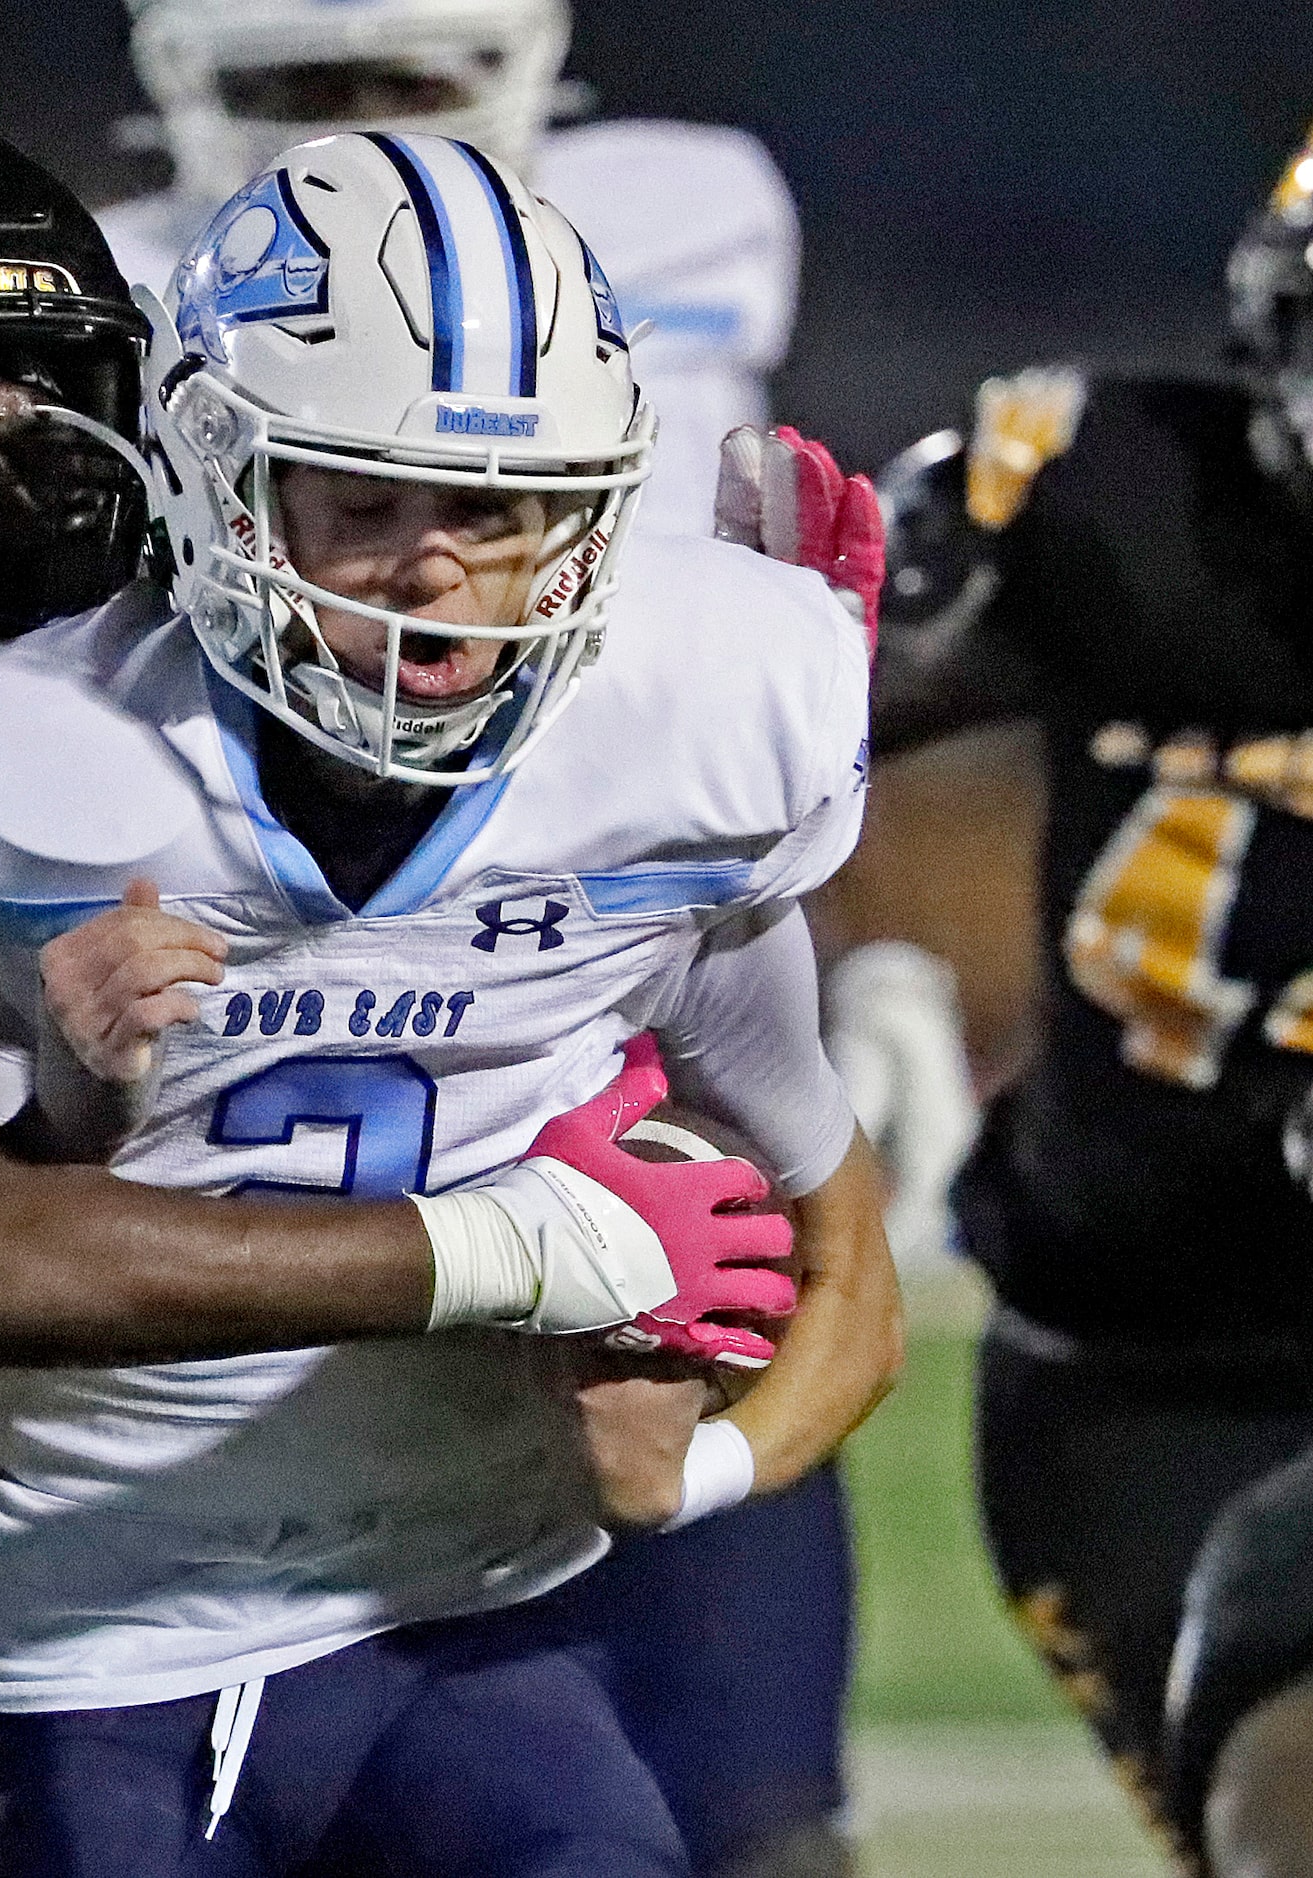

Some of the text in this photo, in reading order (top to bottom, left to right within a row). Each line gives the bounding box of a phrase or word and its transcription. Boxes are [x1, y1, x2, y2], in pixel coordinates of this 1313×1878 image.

[535, 528, 610, 619] Riddell
[393, 716, 446, 734] iddell
[221, 988, 475, 1038] DUB EAST
